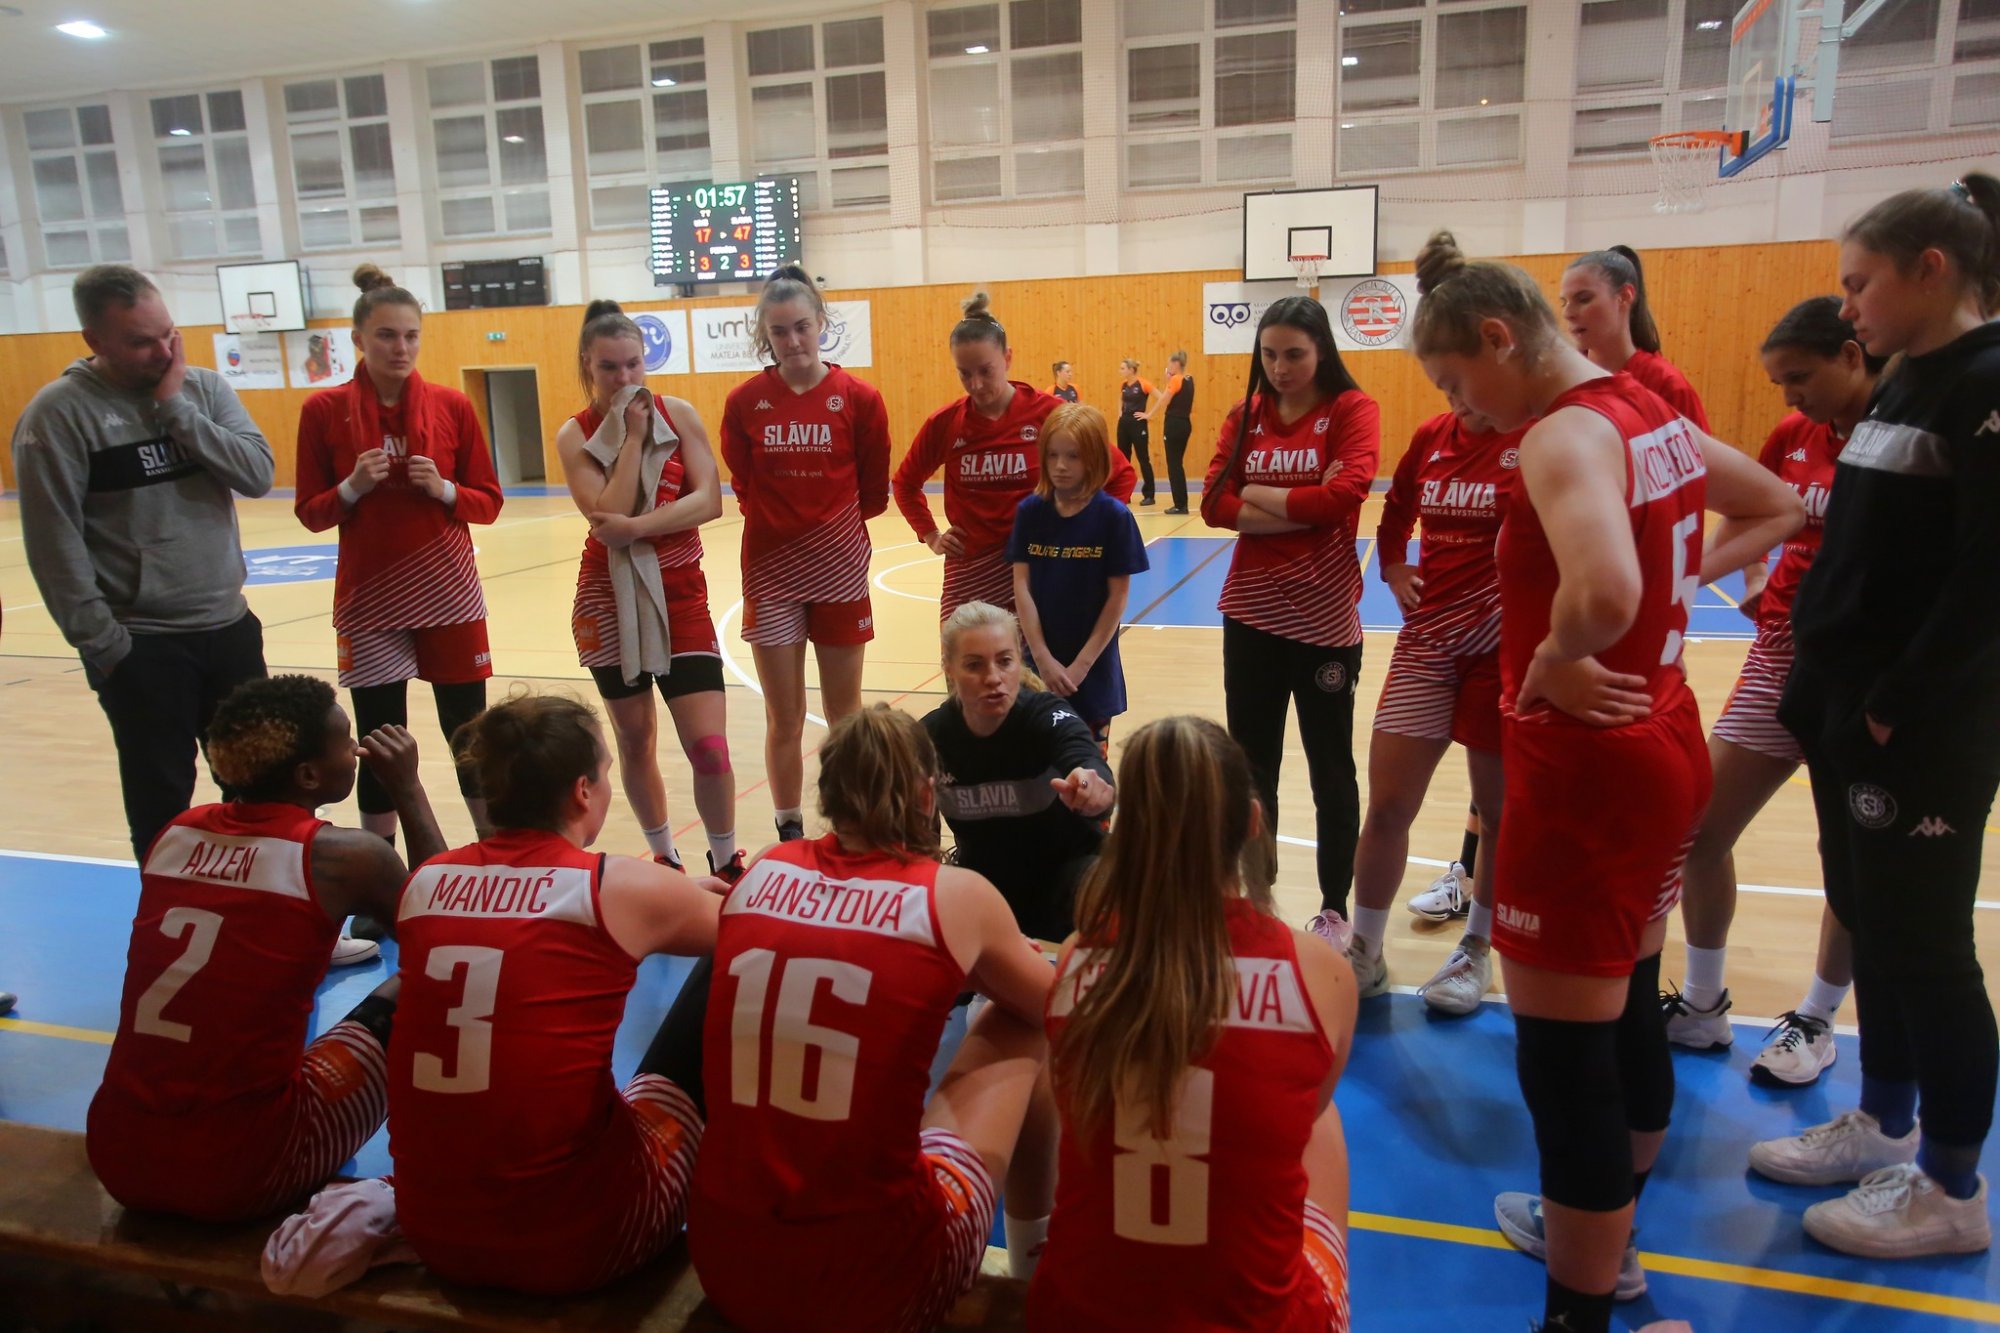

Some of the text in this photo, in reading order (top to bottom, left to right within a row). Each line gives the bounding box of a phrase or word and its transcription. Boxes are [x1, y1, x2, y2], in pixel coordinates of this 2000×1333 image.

[695, 185, 747, 208] 01:57
[696, 228, 712, 243] 17
[733, 226, 751, 241] 47
[700, 257, 710, 271] 3
[720, 256, 729, 270] 2
[740, 254, 750, 268] 3
[764, 420, 832, 446] SLÁVIA
[796, 445, 832, 453] BYSTRICA
[960, 450, 1027, 475] SLÁVIA
[1245, 446, 1320, 474] SLÁVIA
[1420, 477, 1496, 509] SLÁVIA
[1450, 508, 1496, 518] BYSTRICA
[1660, 512, 1700, 666] 5
[181, 841, 259, 883] ALLEN
[427, 869, 557, 914] MANDIĆ
[746, 870, 906, 932] JANŠTOVÁ
[1497, 903, 1540, 931] SLÁVIA
[134, 906, 224, 1043] 2
[412, 945, 505, 1094] 3
[728, 947, 873, 1121] 16
[1113, 1064, 1214, 1246] 8
